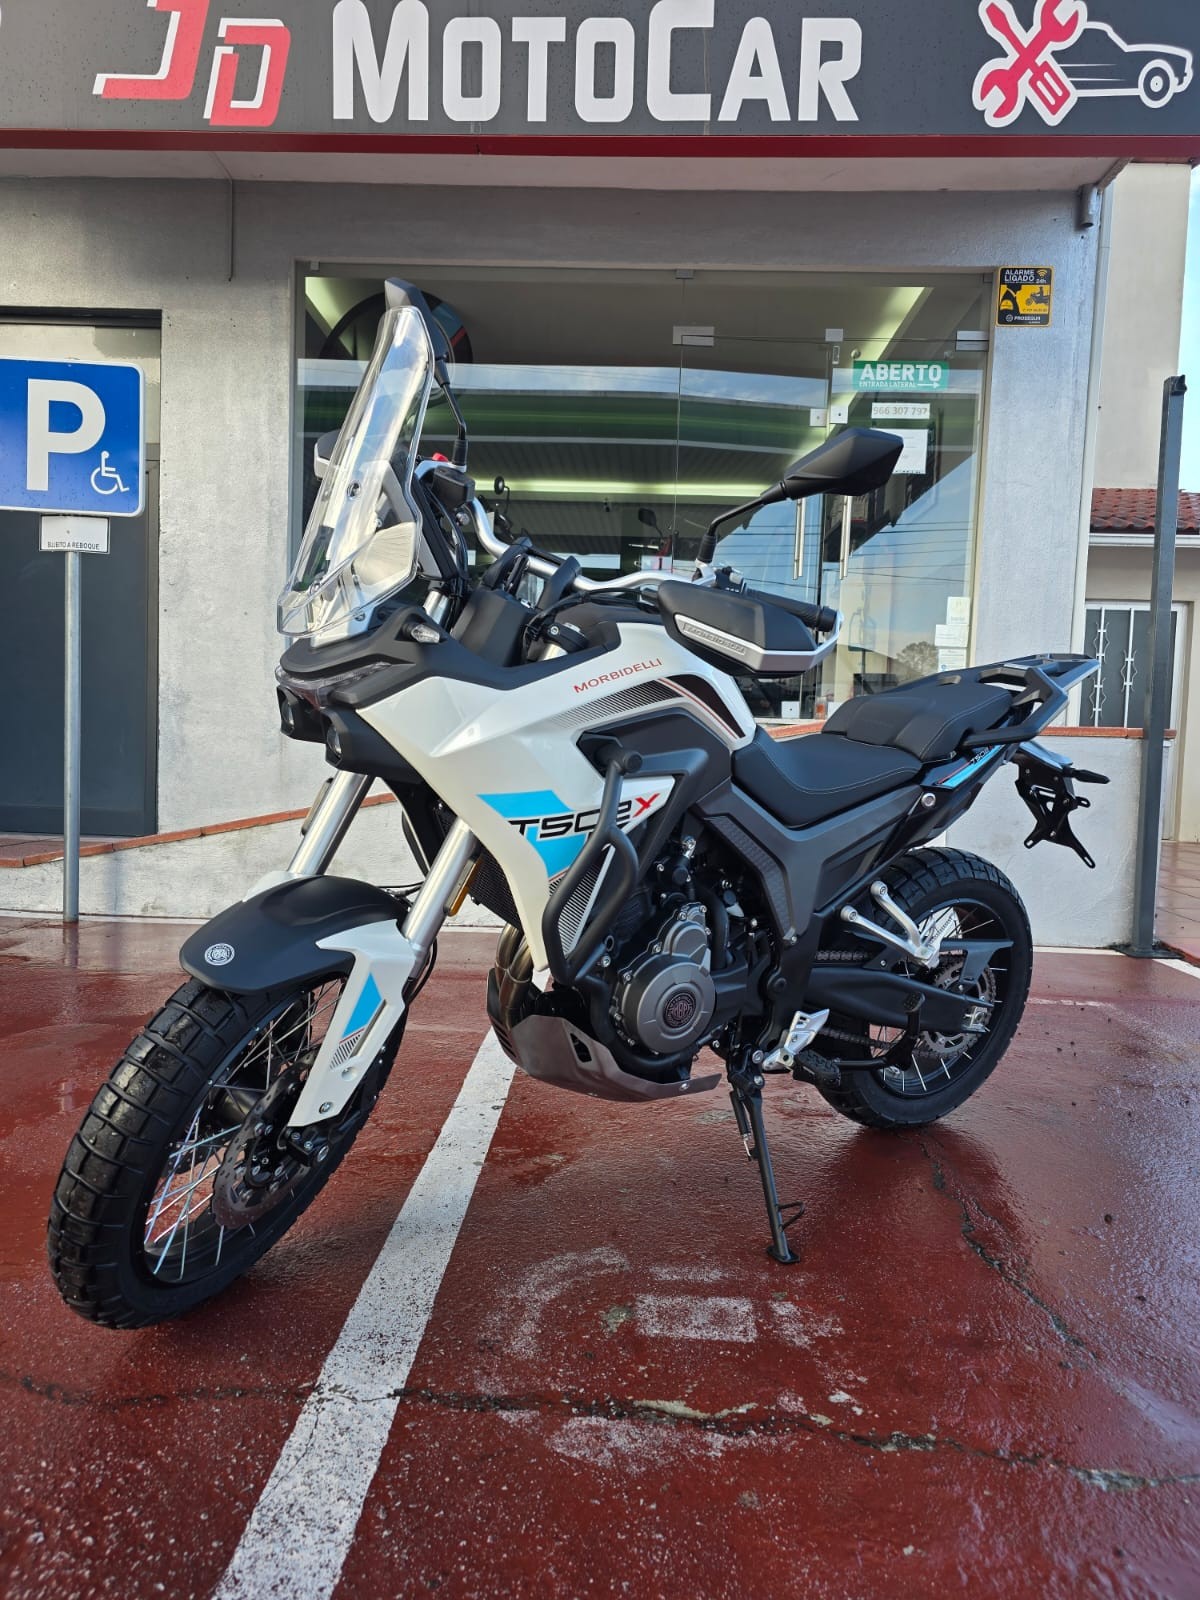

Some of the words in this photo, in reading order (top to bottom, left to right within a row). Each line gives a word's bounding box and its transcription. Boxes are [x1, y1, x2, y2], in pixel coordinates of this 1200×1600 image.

[860, 363, 942, 382] ABERTO
[873, 407, 890, 415] 966
[893, 407, 909, 415] 307
[911, 407, 928, 416] 797
[26, 378, 106, 491] P
[72, 542, 100, 550] REBOQUE
[573, 658, 663, 693] MORBIDELLI
